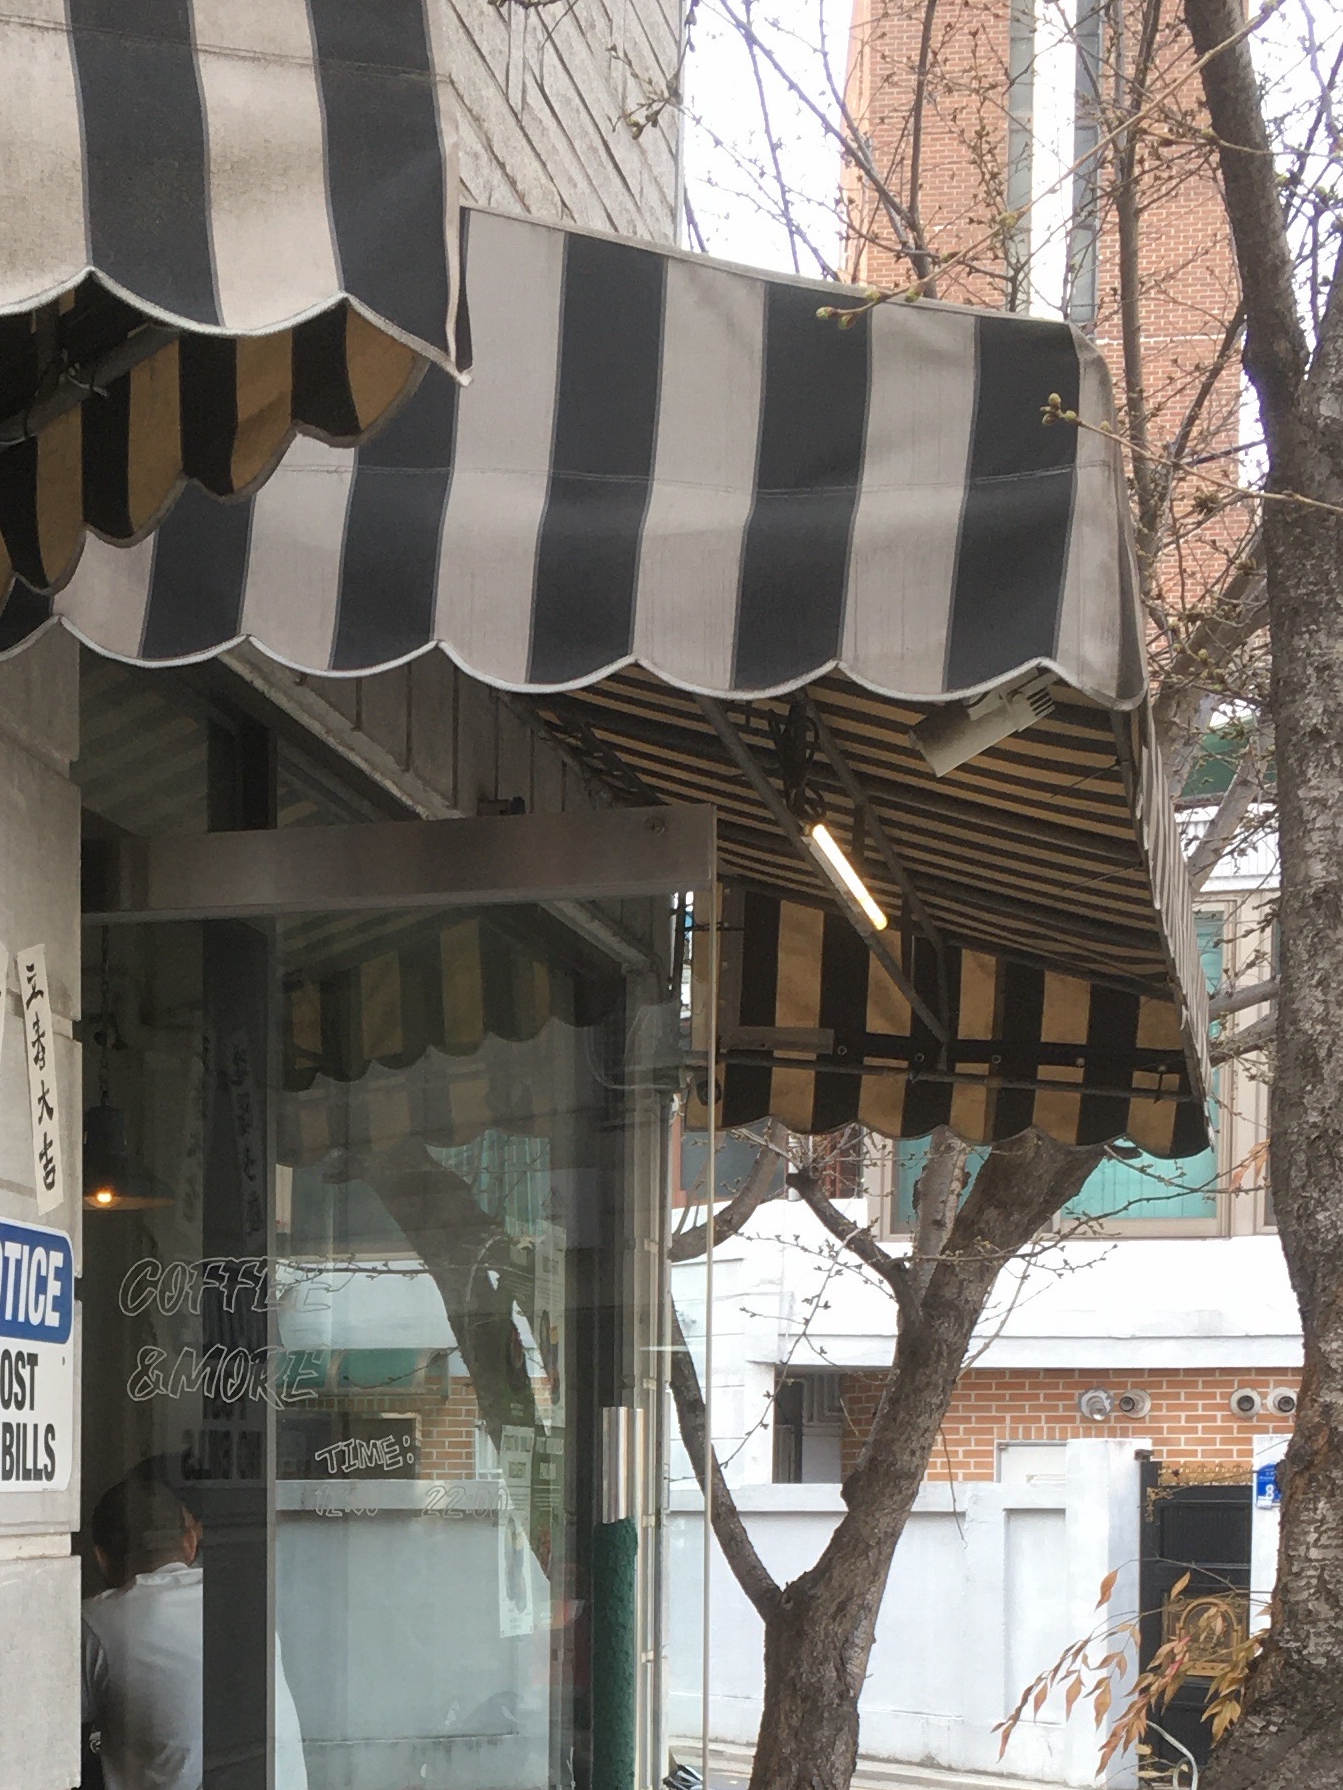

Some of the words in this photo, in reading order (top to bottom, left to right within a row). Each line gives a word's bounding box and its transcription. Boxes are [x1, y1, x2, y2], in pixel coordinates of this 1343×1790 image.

[26, 964, 56, 1191] 立春大吉
[118, 1257, 337, 1316] COFFEE
[126, 1344, 325, 1410] &MORE
[1, 1421, 56, 1482] BILLS
[315, 1435, 415, 1475] TIME:
